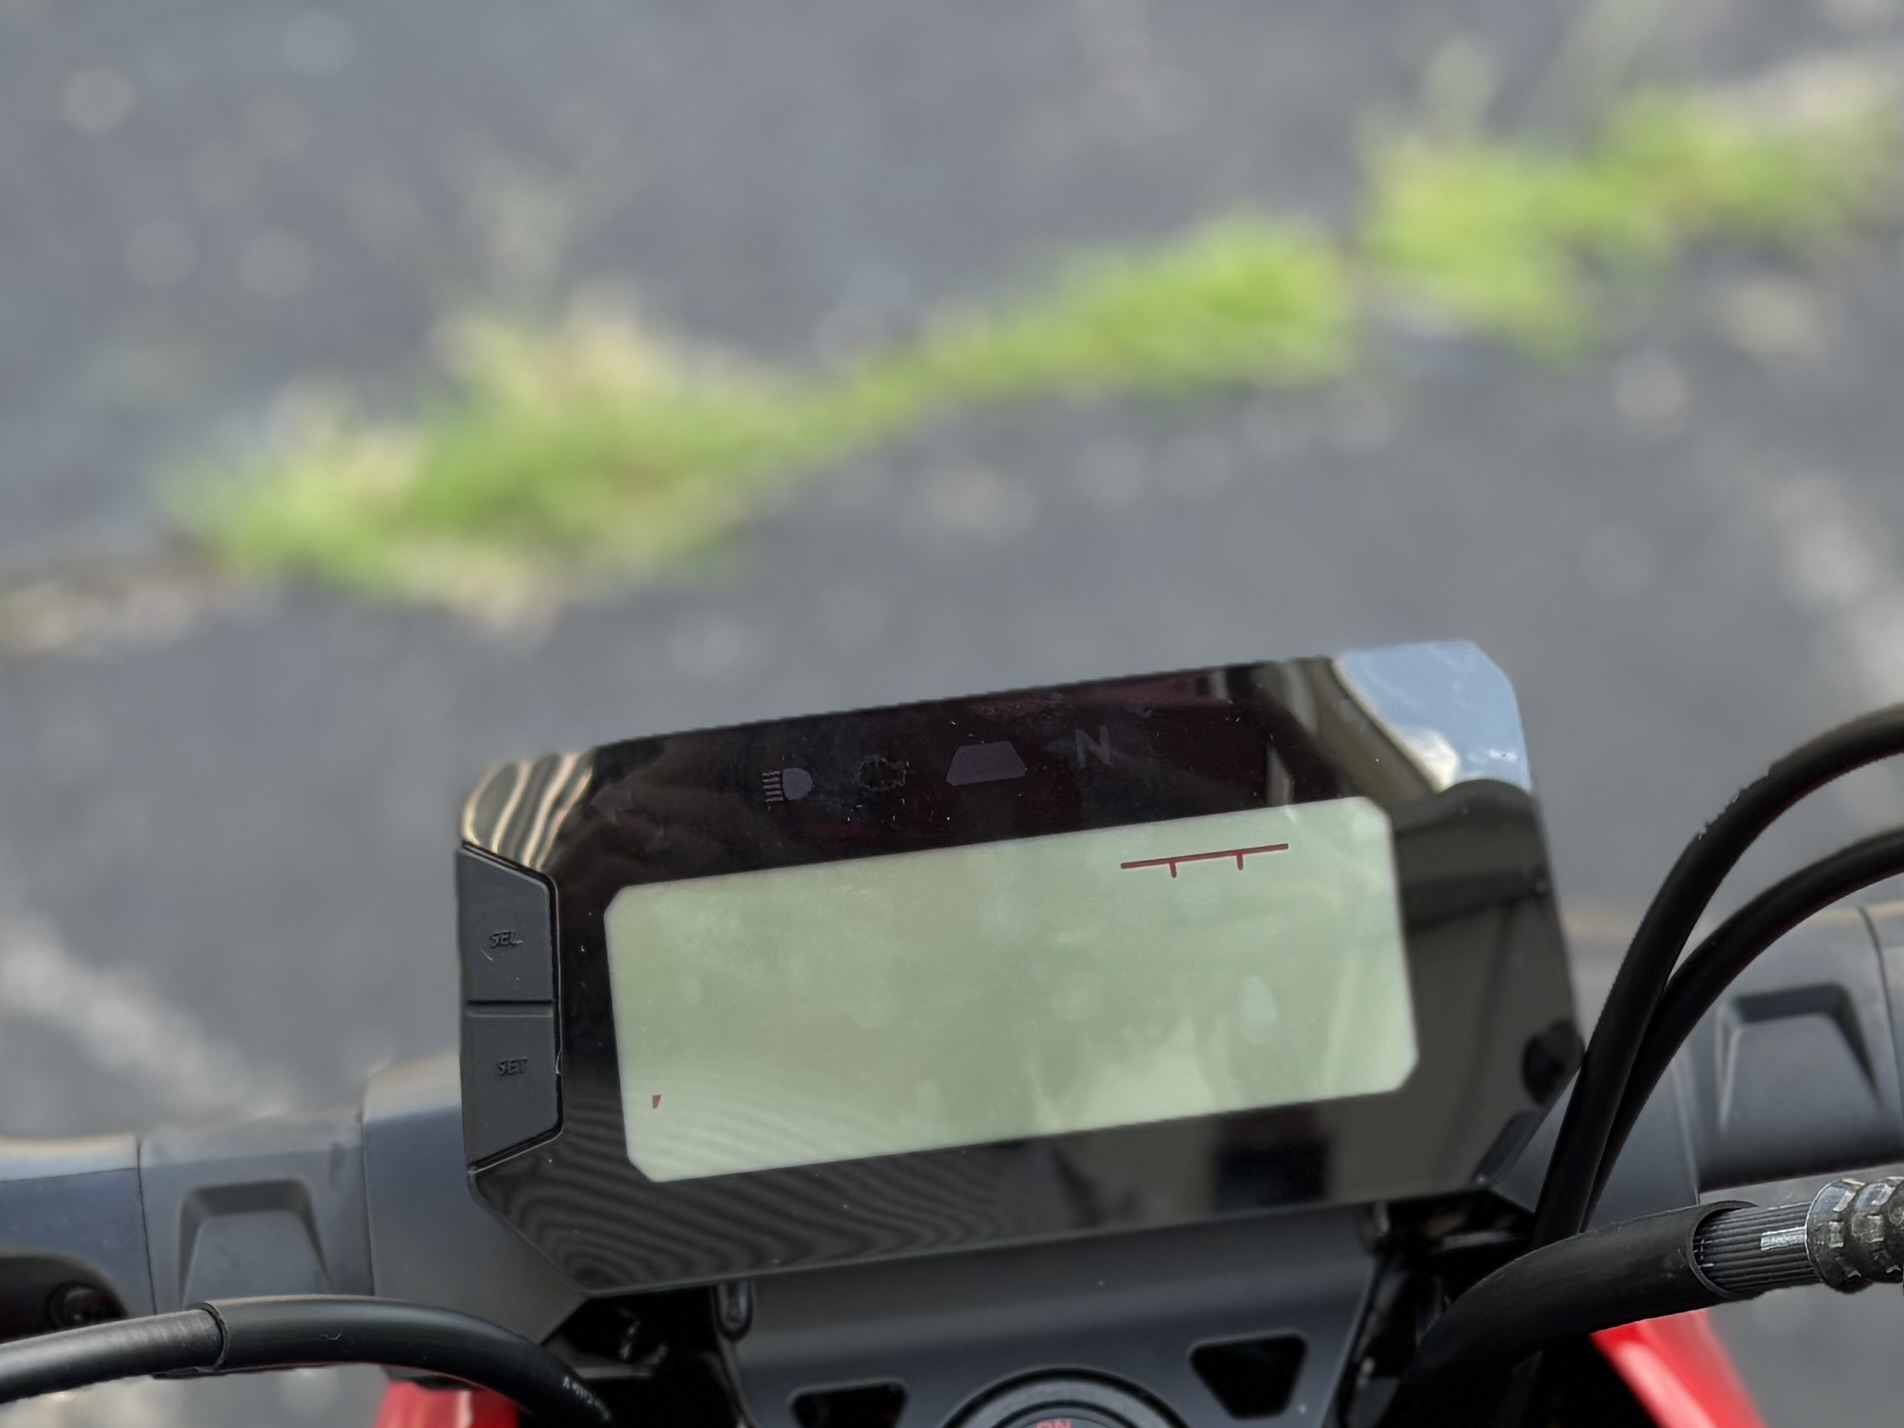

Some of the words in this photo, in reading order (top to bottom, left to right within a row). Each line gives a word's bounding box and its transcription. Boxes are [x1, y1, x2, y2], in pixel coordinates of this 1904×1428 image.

[1073, 724, 1114, 769] N
[489, 929, 524, 949] SEL
[497, 1057, 529, 1077] SET
